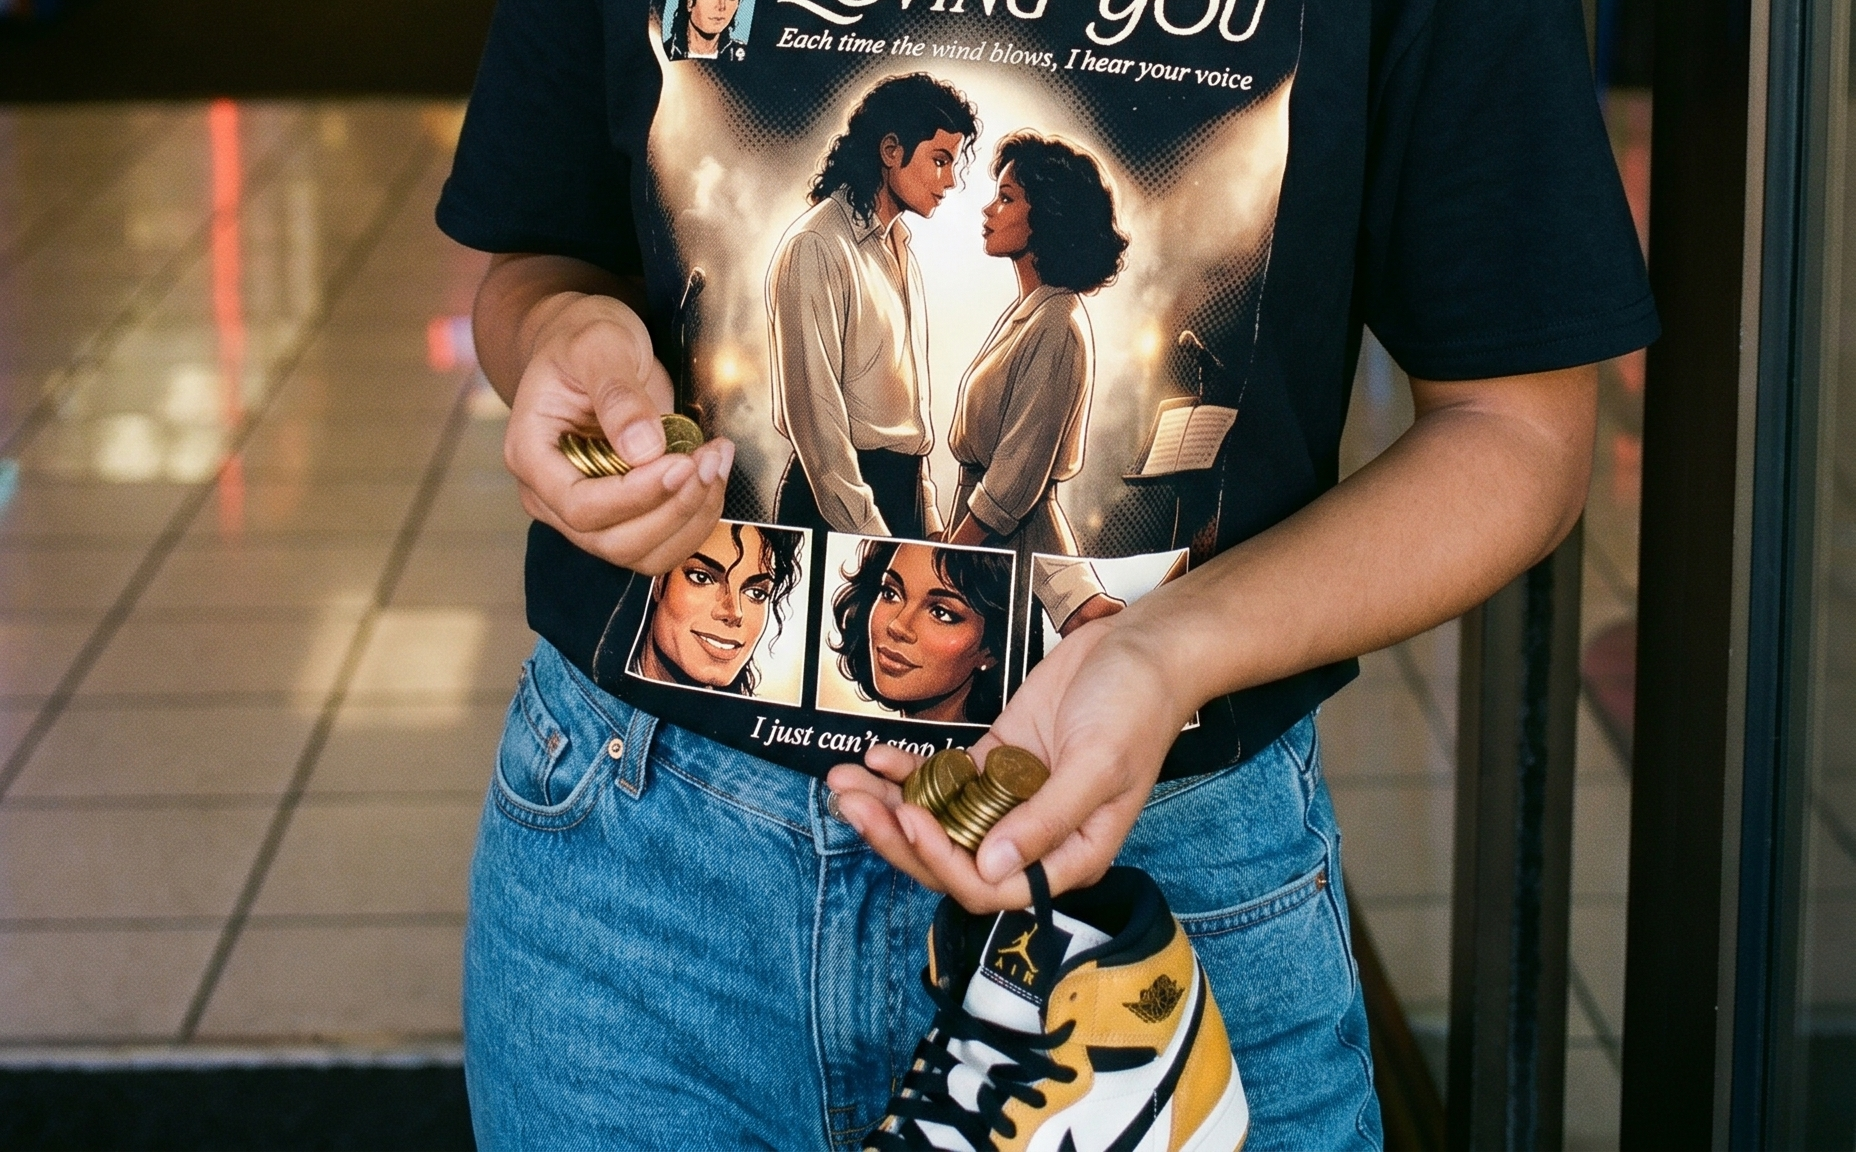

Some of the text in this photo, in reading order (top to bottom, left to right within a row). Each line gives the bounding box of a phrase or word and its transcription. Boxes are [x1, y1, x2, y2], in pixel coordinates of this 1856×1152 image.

[776, 27, 1253, 91] Each time the wind blows, I hear your voice
[750, 716, 767, 739] I
[763, 718, 815, 746] just
[995, 956, 1034, 986] AIR
